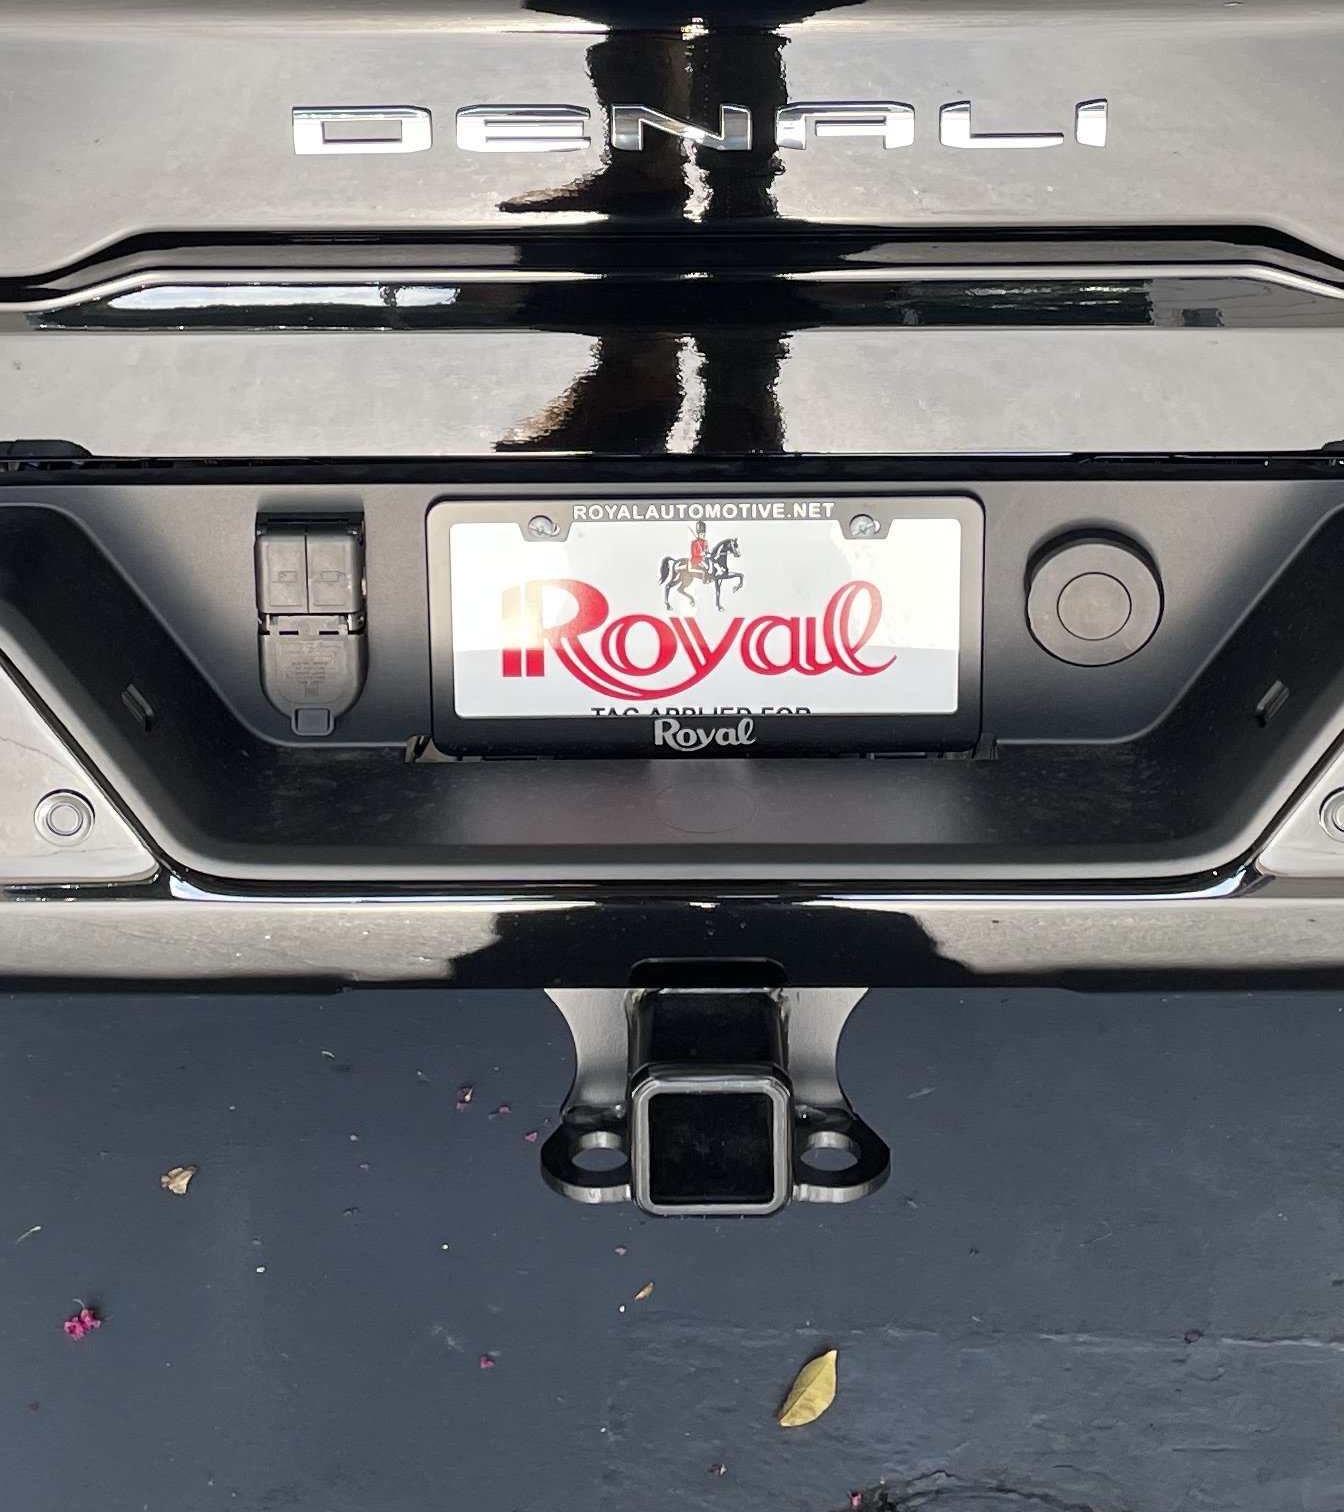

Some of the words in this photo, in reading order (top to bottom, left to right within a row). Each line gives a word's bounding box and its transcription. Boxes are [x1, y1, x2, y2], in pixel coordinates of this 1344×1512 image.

[291, 98, 1108, 156] DENALI
[572, 502, 836, 520] ROYALAUTOMOTIVE.NET
[500, 578, 897, 701] Royal
[654, 718, 757, 752] Royal
